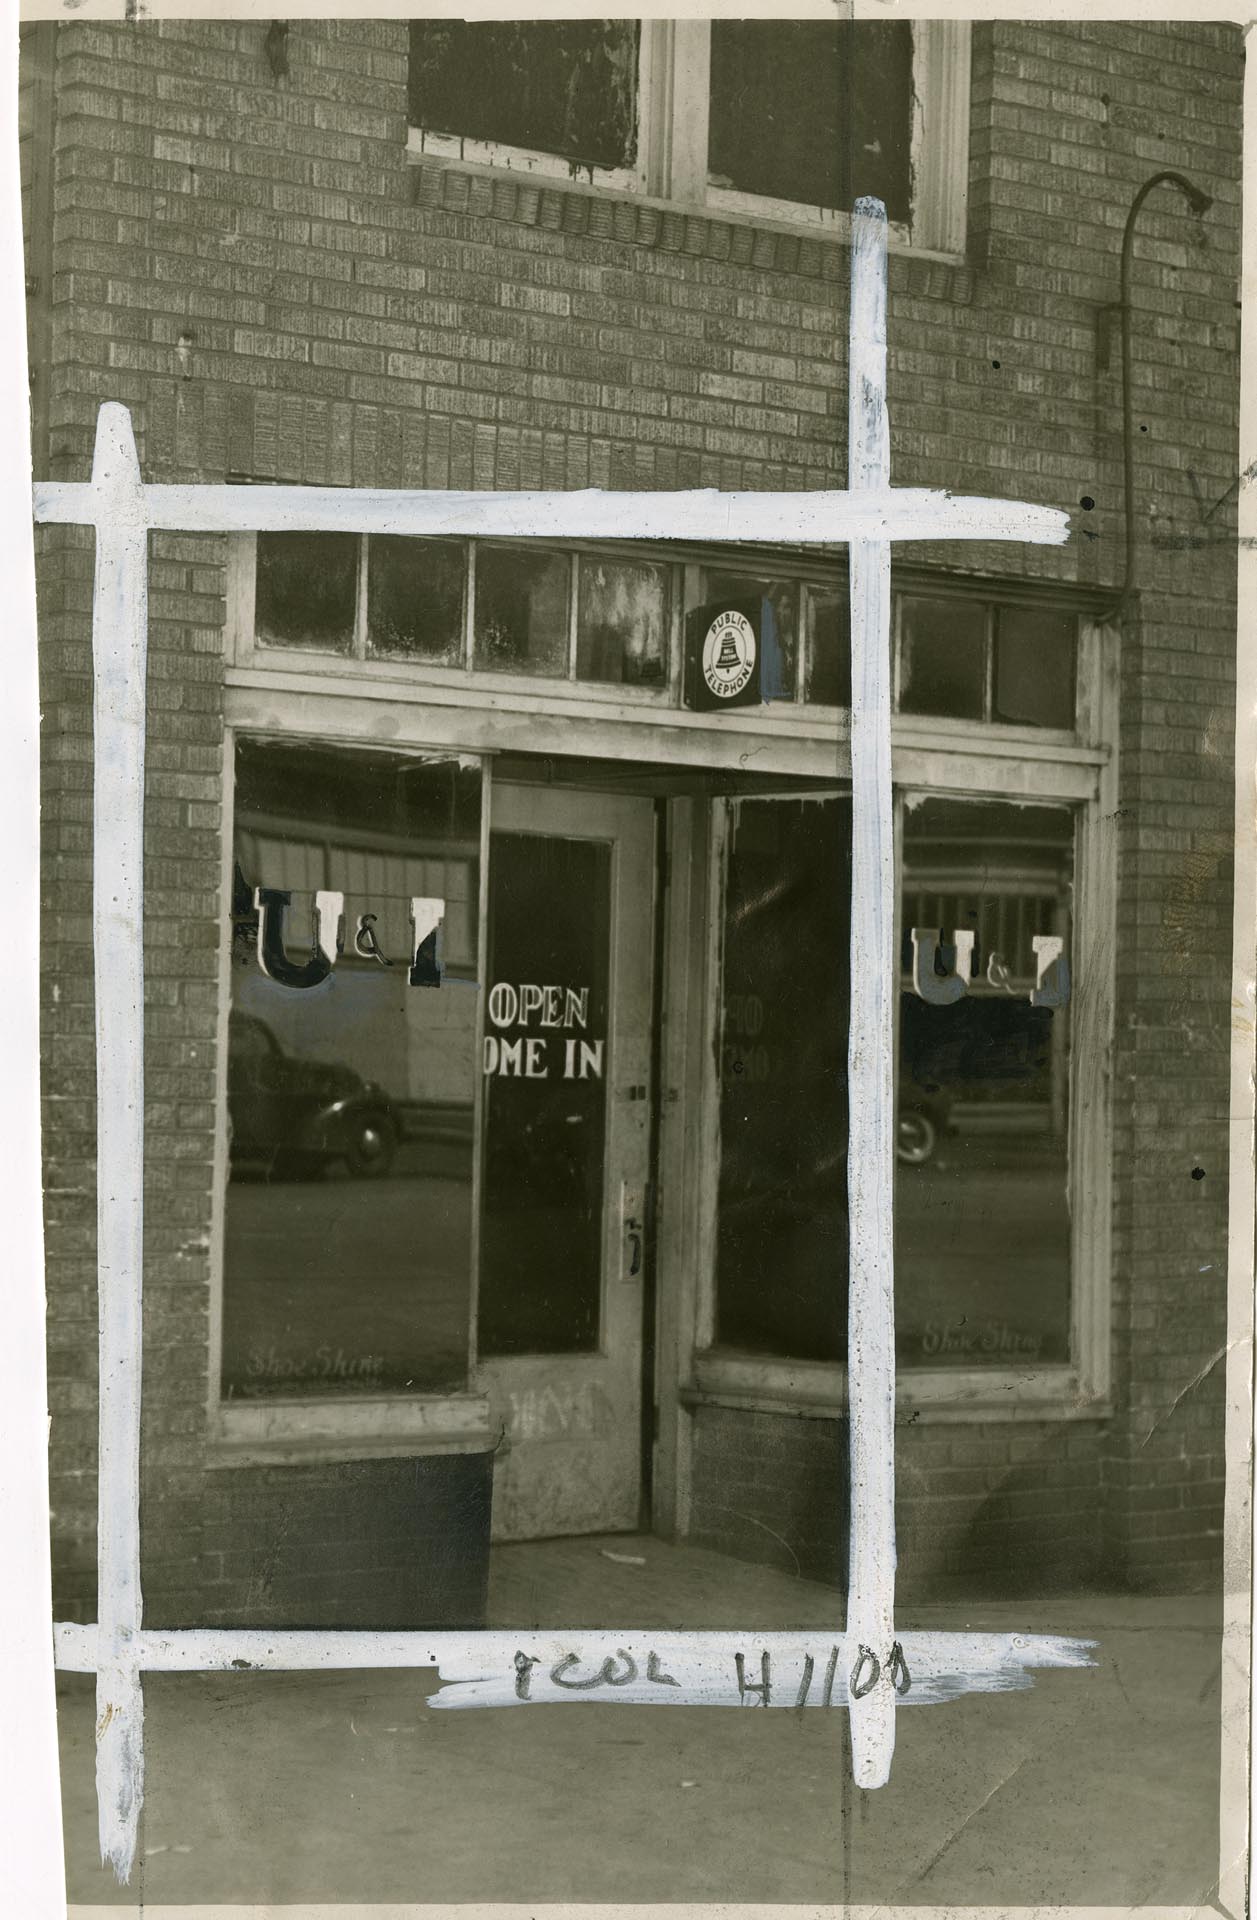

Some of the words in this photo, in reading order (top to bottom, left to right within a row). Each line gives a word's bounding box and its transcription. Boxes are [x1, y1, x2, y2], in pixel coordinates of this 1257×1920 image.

[711, 613, 748, 634] PUBLIC
[705, 659, 753, 695] TELEPHONE
[489, 982, 589, 1028] OPEN
[483, 1036, 548, 1078] OME
[563, 1039, 604, 1079] IN
